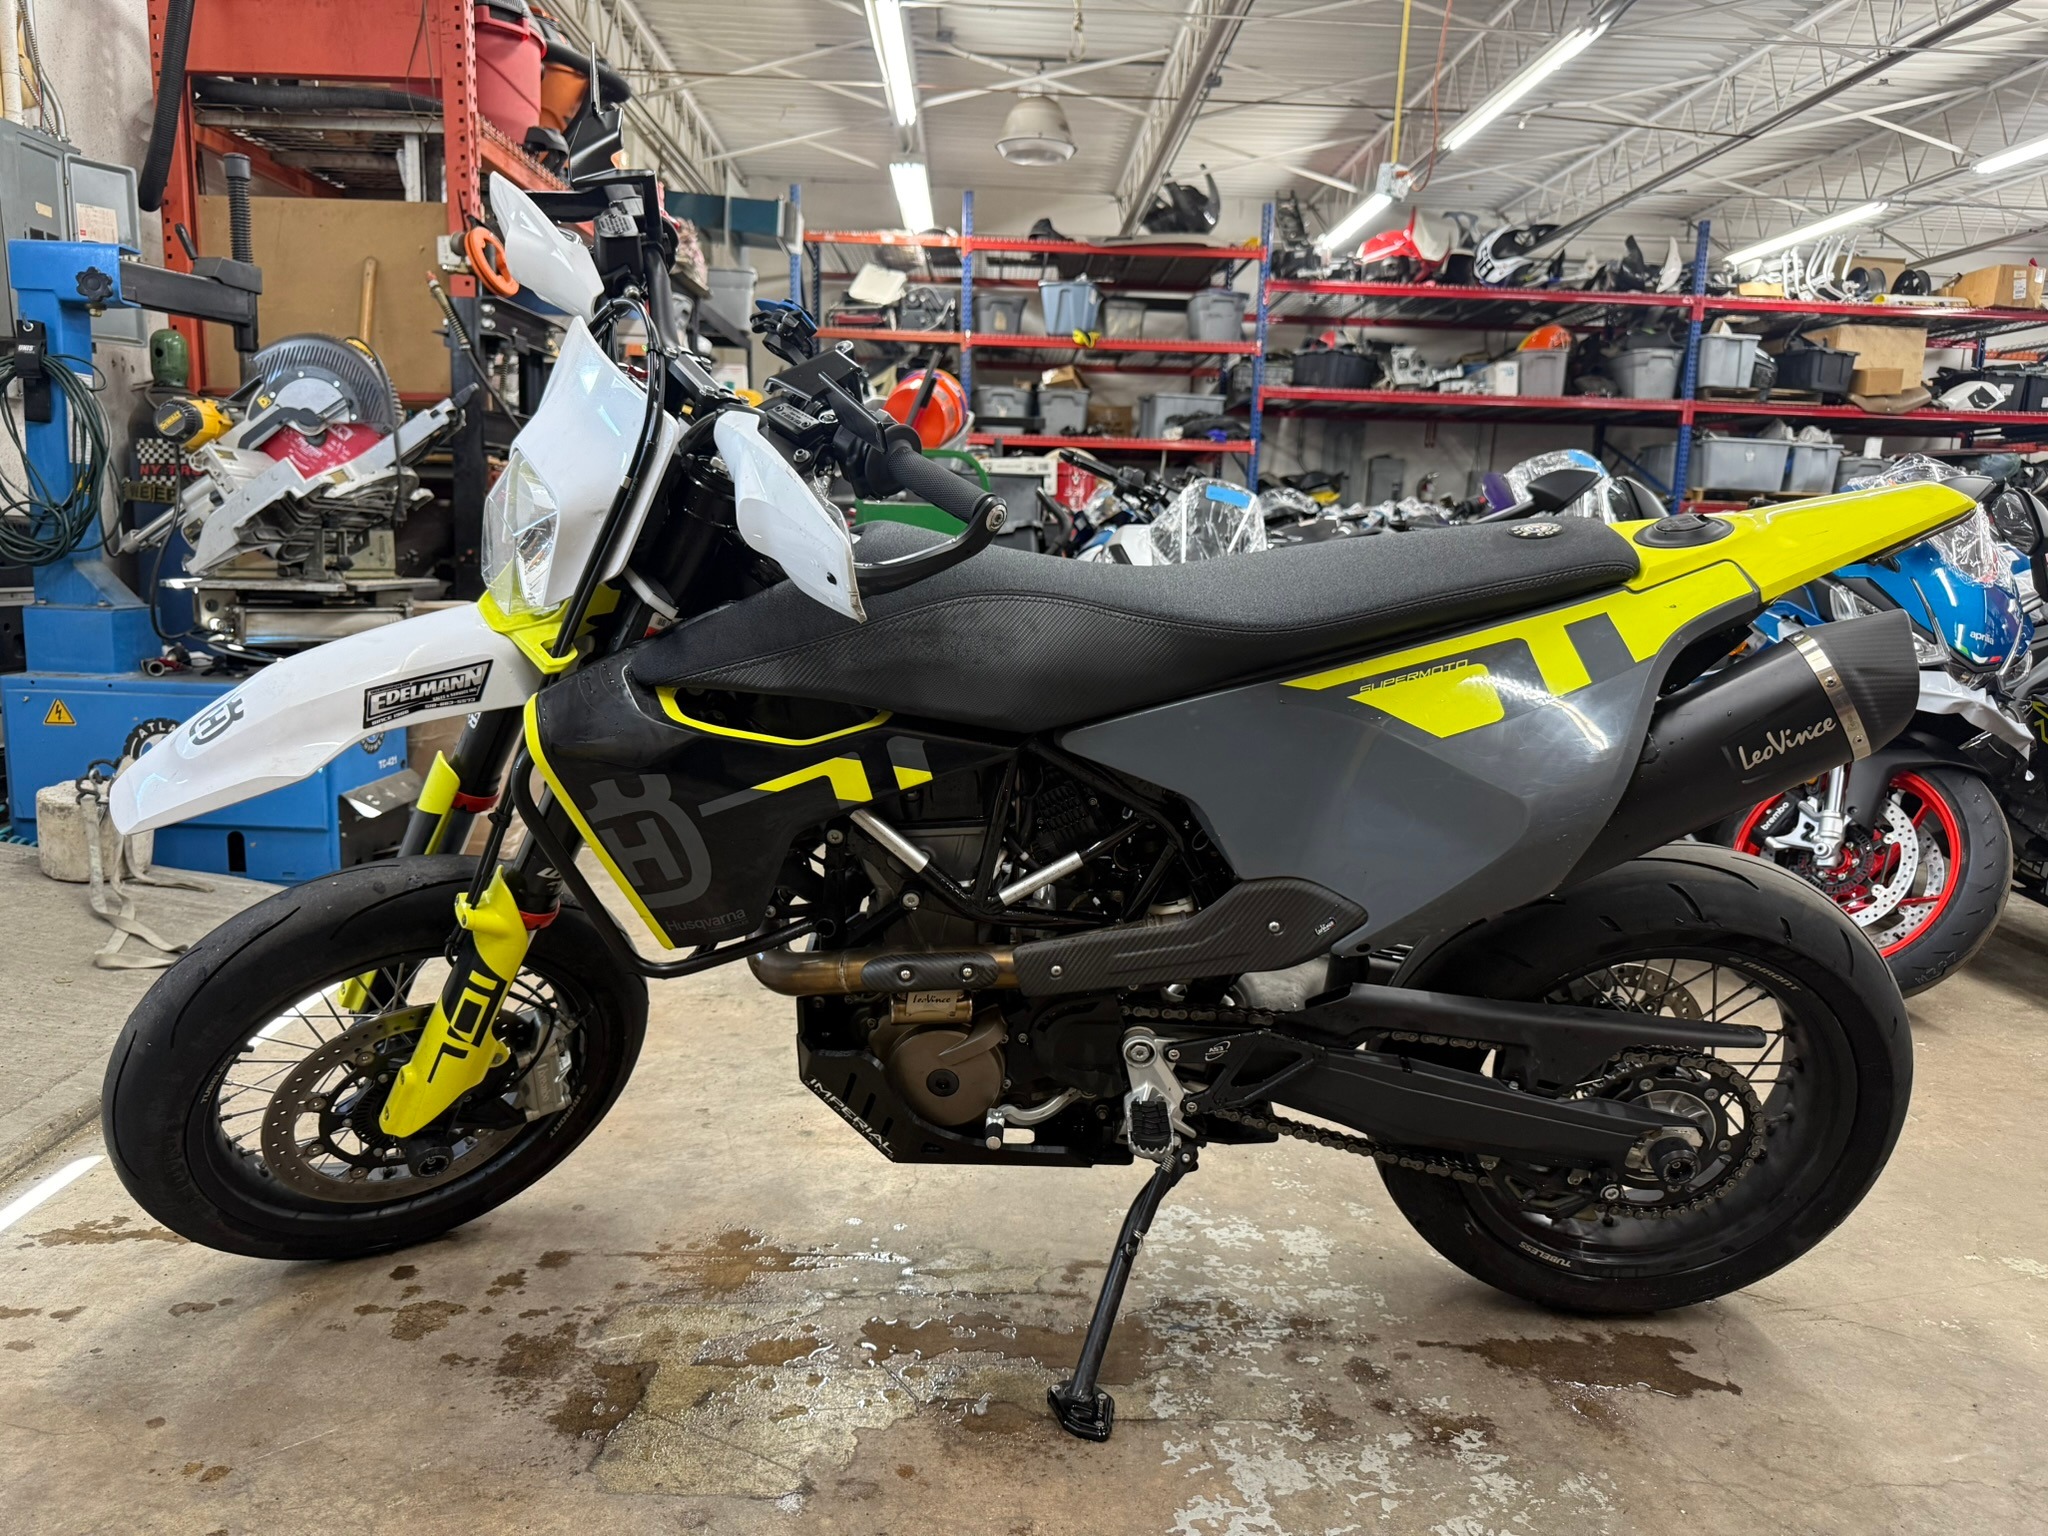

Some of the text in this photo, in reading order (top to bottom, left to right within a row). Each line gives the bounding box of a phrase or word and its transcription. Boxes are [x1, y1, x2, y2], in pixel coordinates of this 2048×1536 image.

[1969, 631, 1994, 645] aprilia
[1359, 659, 1468, 692] SUPERMOTO
[369, 665, 486, 717] EDELMANN
[138, 721, 177, 739] ATLA
[371, 715, 393, 726] SINCE
[1738, 717, 1837, 770] LeoVince
[1760, 801, 1790, 830] brembo
[665, 908, 747, 932] Husqvarna
[810, 1078, 894, 1154] IMPERIAL
[1518, 1241, 1571, 1268] TUBELESS
